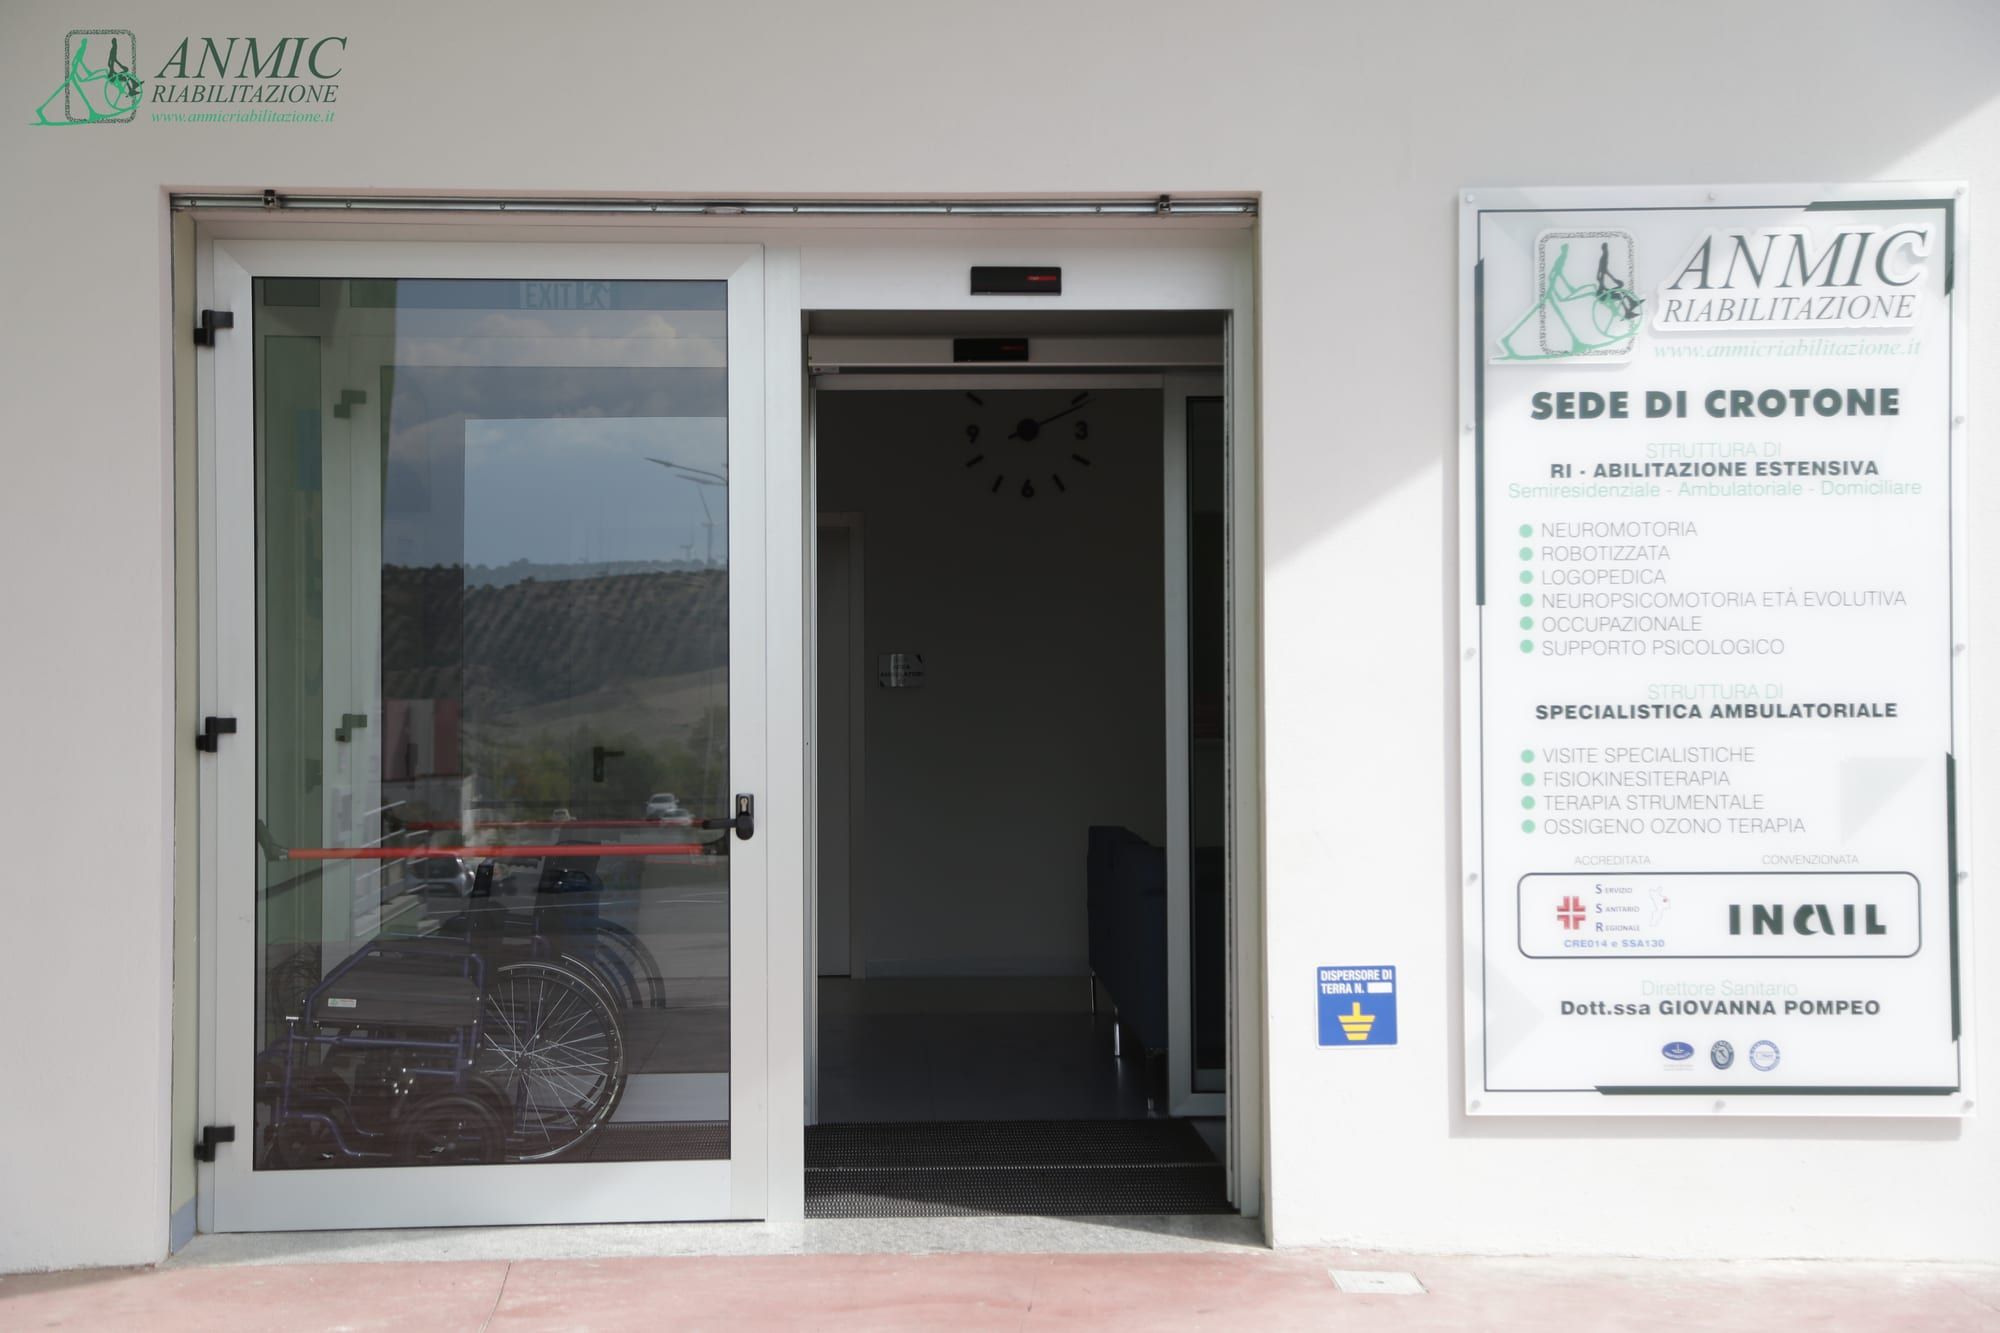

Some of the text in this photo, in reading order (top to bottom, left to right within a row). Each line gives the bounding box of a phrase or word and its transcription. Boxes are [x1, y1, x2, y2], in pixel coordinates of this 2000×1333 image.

[1667, 231, 1927, 290] ANMIC
[1664, 295, 1915, 322] RIABILITAZIONE
[1653, 337, 1922, 361] www.anmicriabilitazione.it
[1531, 388, 1899, 420] SEDE DI CROTONE
[967, 424, 979, 443] 9
[1075, 420, 1088, 440] 3
[1645, 441, 1782, 459] STRUTTURA DI
[1551, 464, 1571, 478] RI
[1594, 462, 1747, 477] ABILITAZIONE
[1756, 461, 1878, 476] ESTENSIVA
[1021, 479, 1034, 498] 6
[1508, 481, 1660, 499] Semiresidenziale
[1679, 481, 1803, 498] Ambulatoriale
[1821, 479, 1923, 497] Domiciliare
[1542, 521, 1697, 538] NEUROMOTORIA
[1542, 545, 1670, 561] ROBOTIZZATA
[1542, 569, 1666, 585] LOGOPEDICA
[1542, 587, 1906, 608] NEUROPSICOMOTORIA ETÀ EVOLUTIVA
[1542, 616, 1702, 632] OCCUPAZIONALE
[1543, 639, 1784, 656] SUPPORTO PSICOLOGICO
[1648, 683, 1783, 701] STRUTTURA DI
[1536, 703, 1897, 719] SPECIALISTICA AMBULATORIALE
[1543, 747, 1754, 763] VISITE SPECIALISTICHE
[1544, 771, 1730, 787] FISIOKINESITERAPIA
[1544, 794, 1764, 810] TERAPIA STRUMENTALE
[1544, 818, 1805, 834] OSSIGENO OZONO TERAPIA
[1575, 856, 1651, 866] ACCREDITATA
[1762, 855, 1858, 864] CONVENZIONATA
[1729, 904, 1886, 935] INAIL
[1321, 969, 1392, 981] DISPERSORE DI
[1321, 983, 1364, 994] TERRA N.
[1640, 980, 1798, 996] Direttore Sanitario
[1561, 1000, 1880, 1015] Dott.ssa GIOVANNA POMPEO
